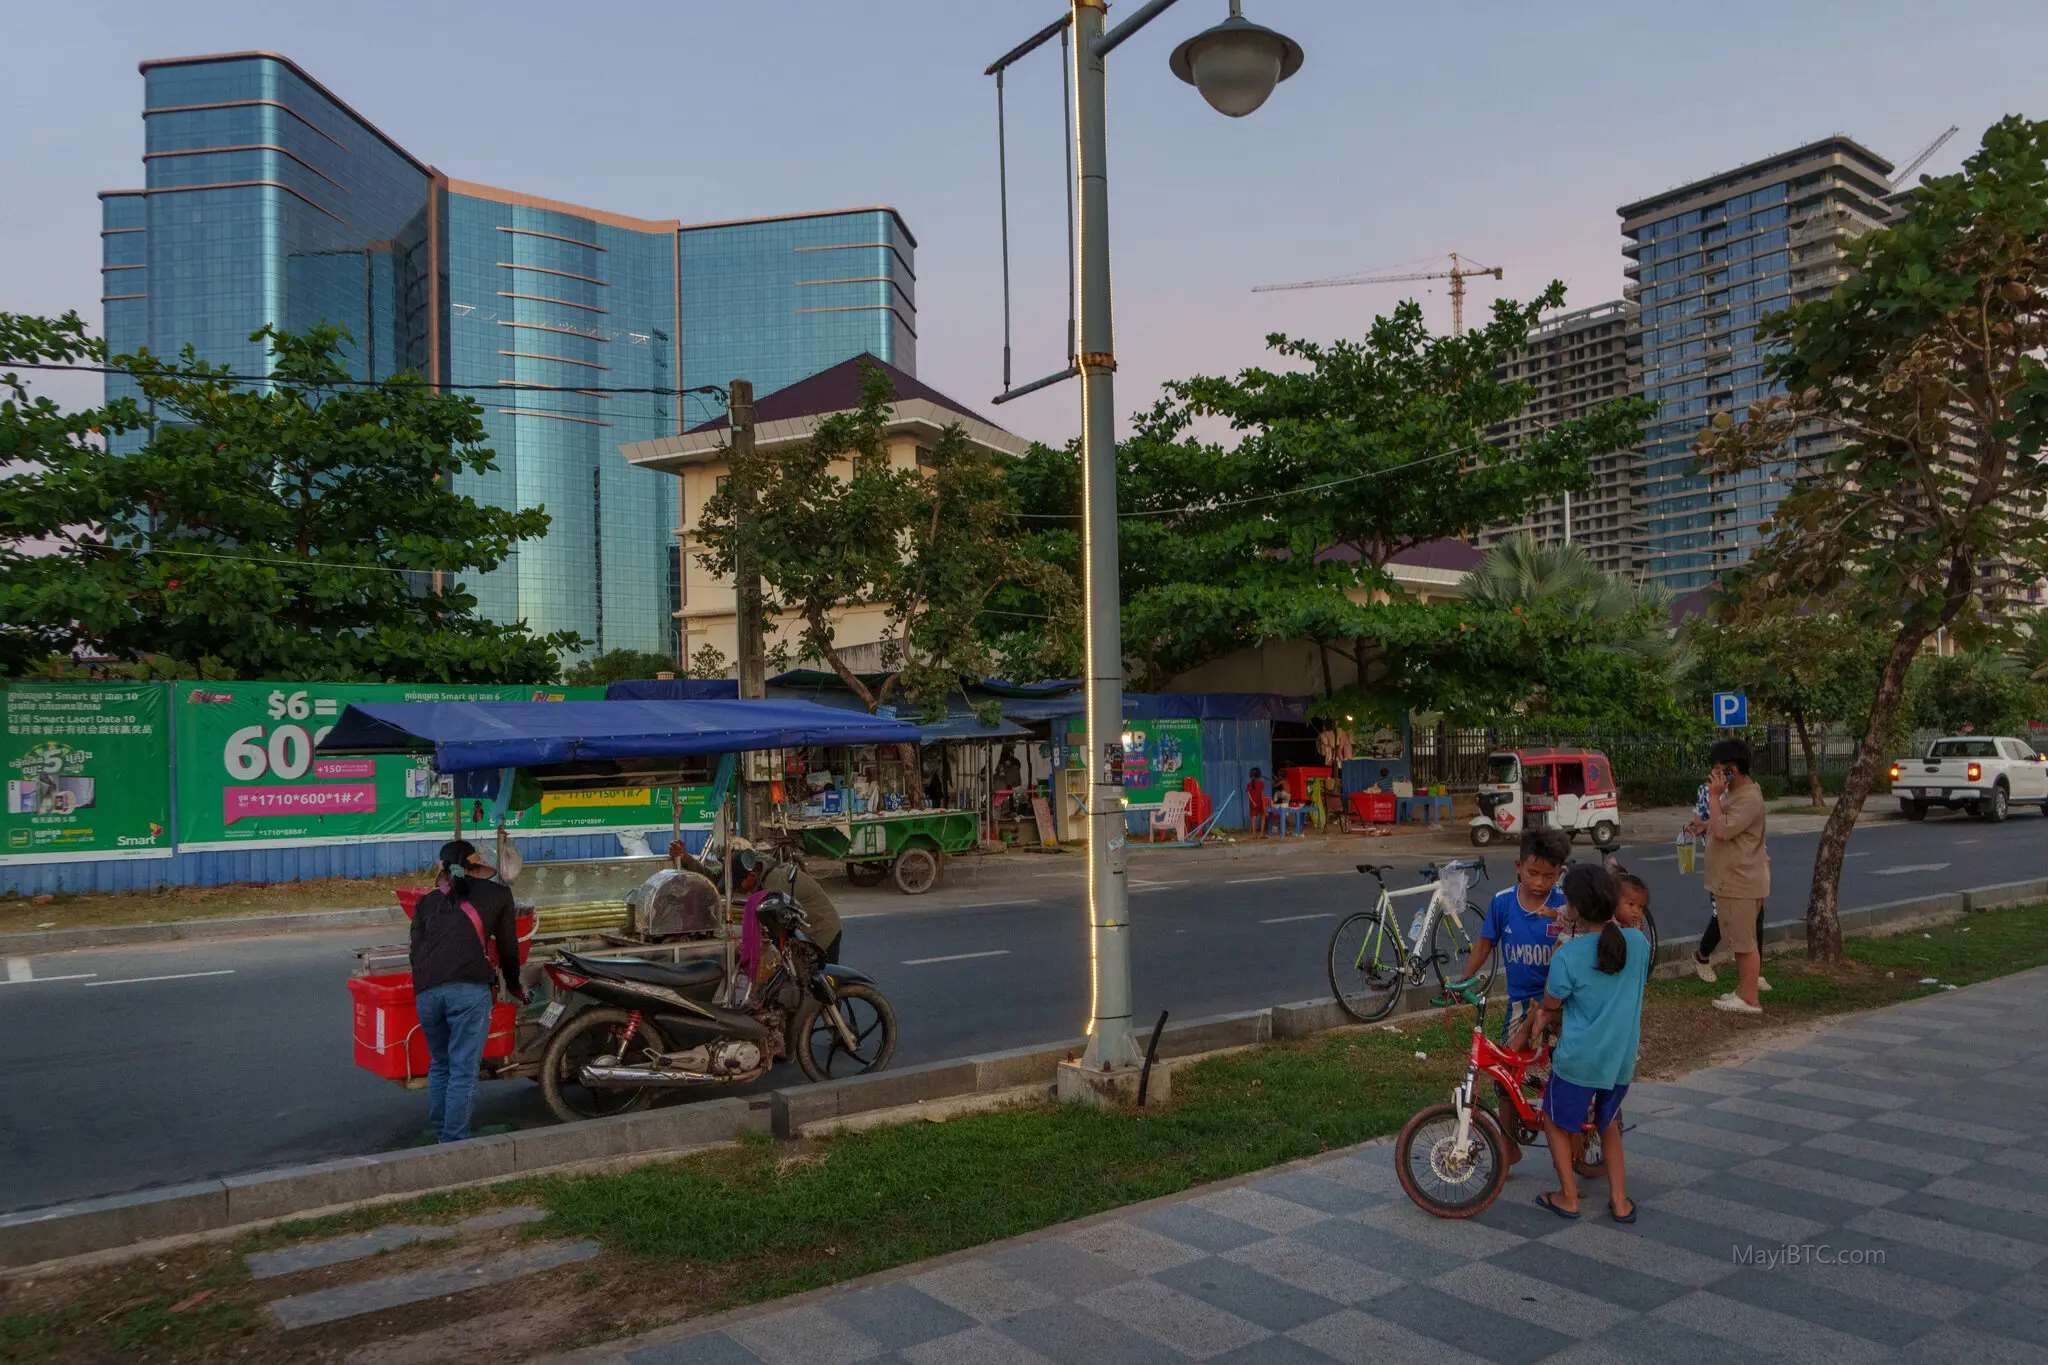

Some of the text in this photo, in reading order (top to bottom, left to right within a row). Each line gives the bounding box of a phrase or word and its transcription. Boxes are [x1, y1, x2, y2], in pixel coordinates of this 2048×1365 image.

[1720, 694, 1740, 725] P
[33, 715, 65, 724] Smart
[123, 715, 137, 724] 10
[117, 833, 156, 847] Smart
[1504, 943, 1552, 966] CAMBOD
